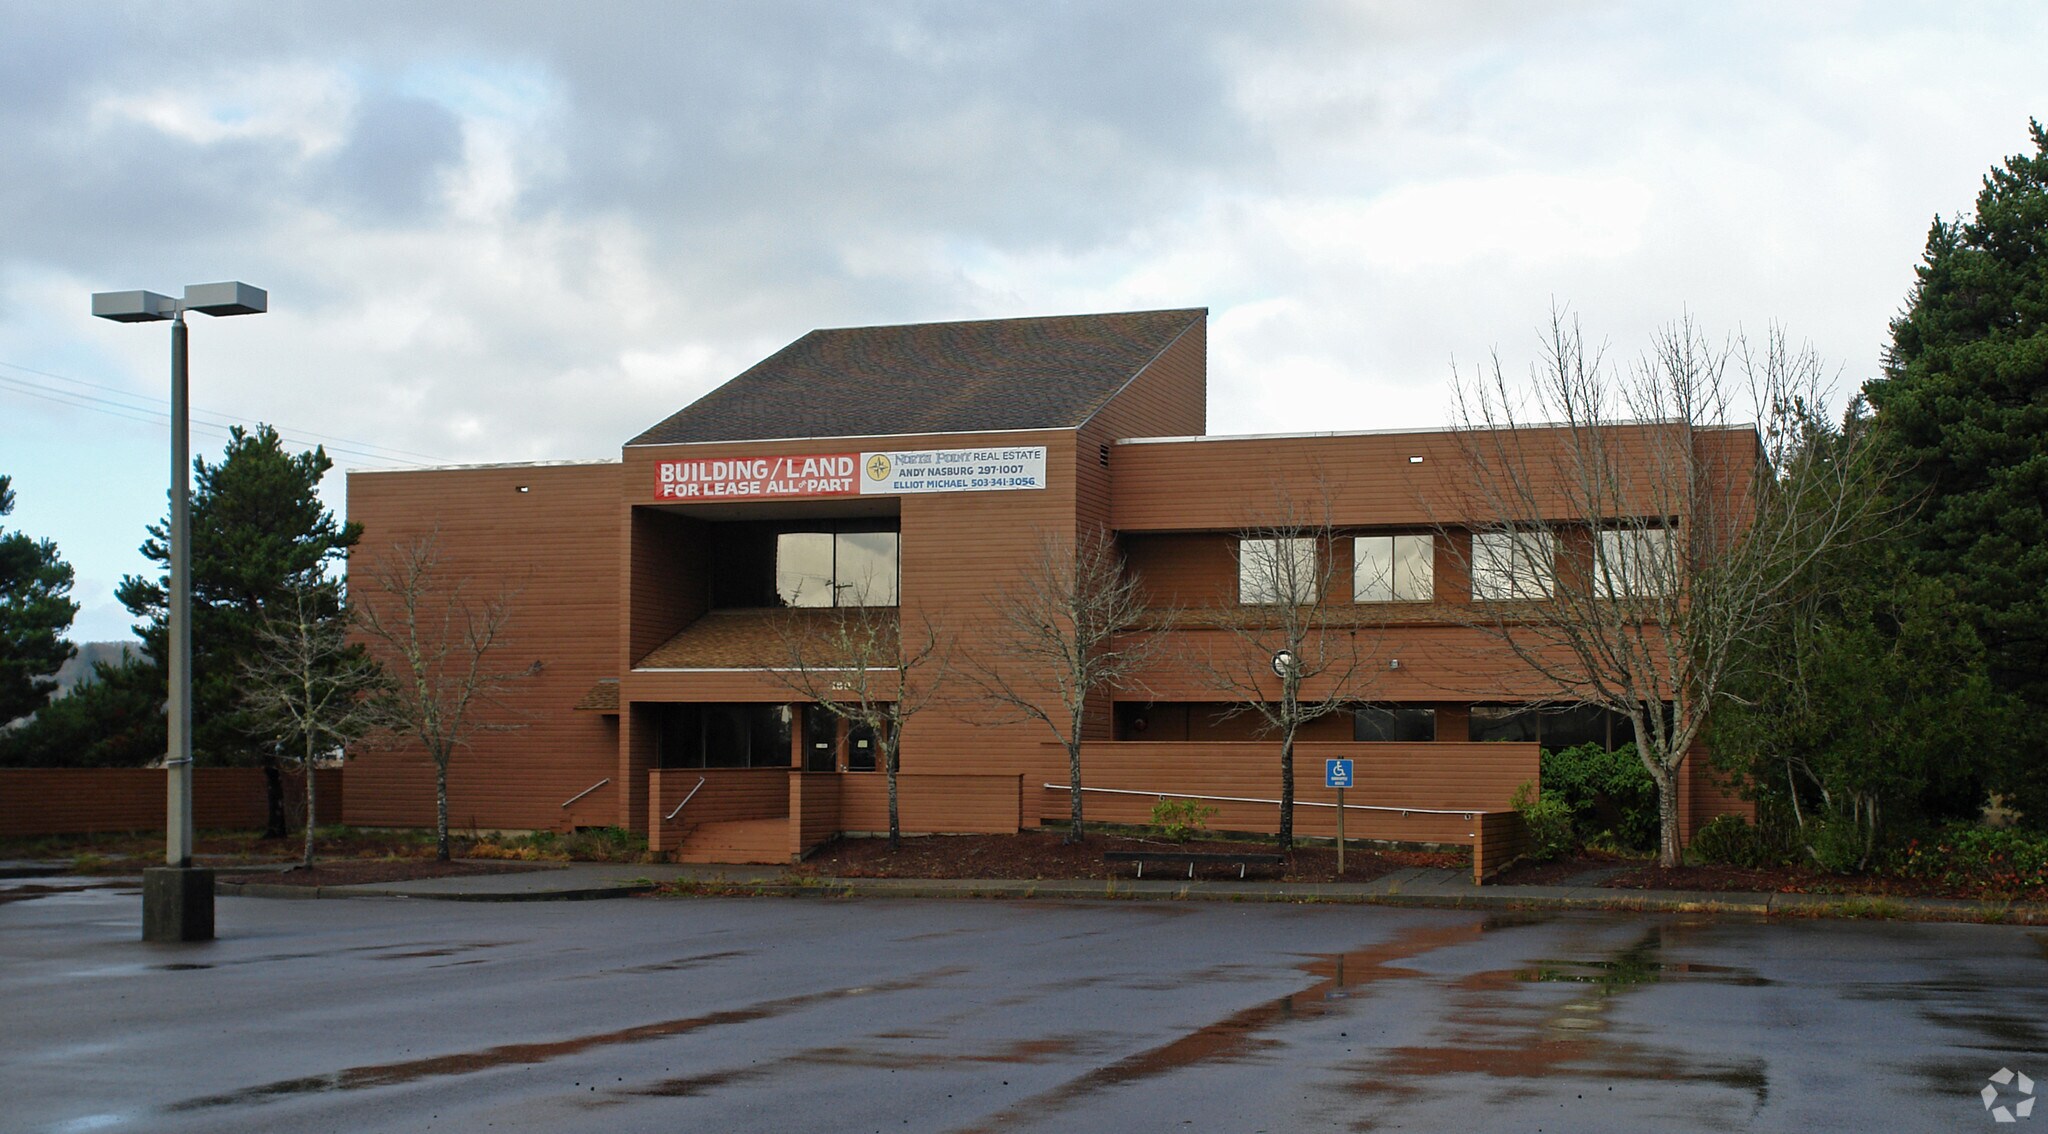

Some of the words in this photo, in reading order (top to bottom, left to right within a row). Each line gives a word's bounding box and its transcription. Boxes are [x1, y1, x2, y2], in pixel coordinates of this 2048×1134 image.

[973, 452, 1000, 461] REAL
[1002, 450, 1041, 460] ESTATE
[898, 468, 925, 478] ANDY
[927, 466, 974, 477] NASBURG
[663, 484, 699, 497] FOR
[703, 482, 760, 496] LEASE
[766, 480, 799, 493] ALL
[807, 478, 853, 492] PART
[893, 480, 925, 489] ELLIOT
[926, 479, 968, 488] MICHAEL
